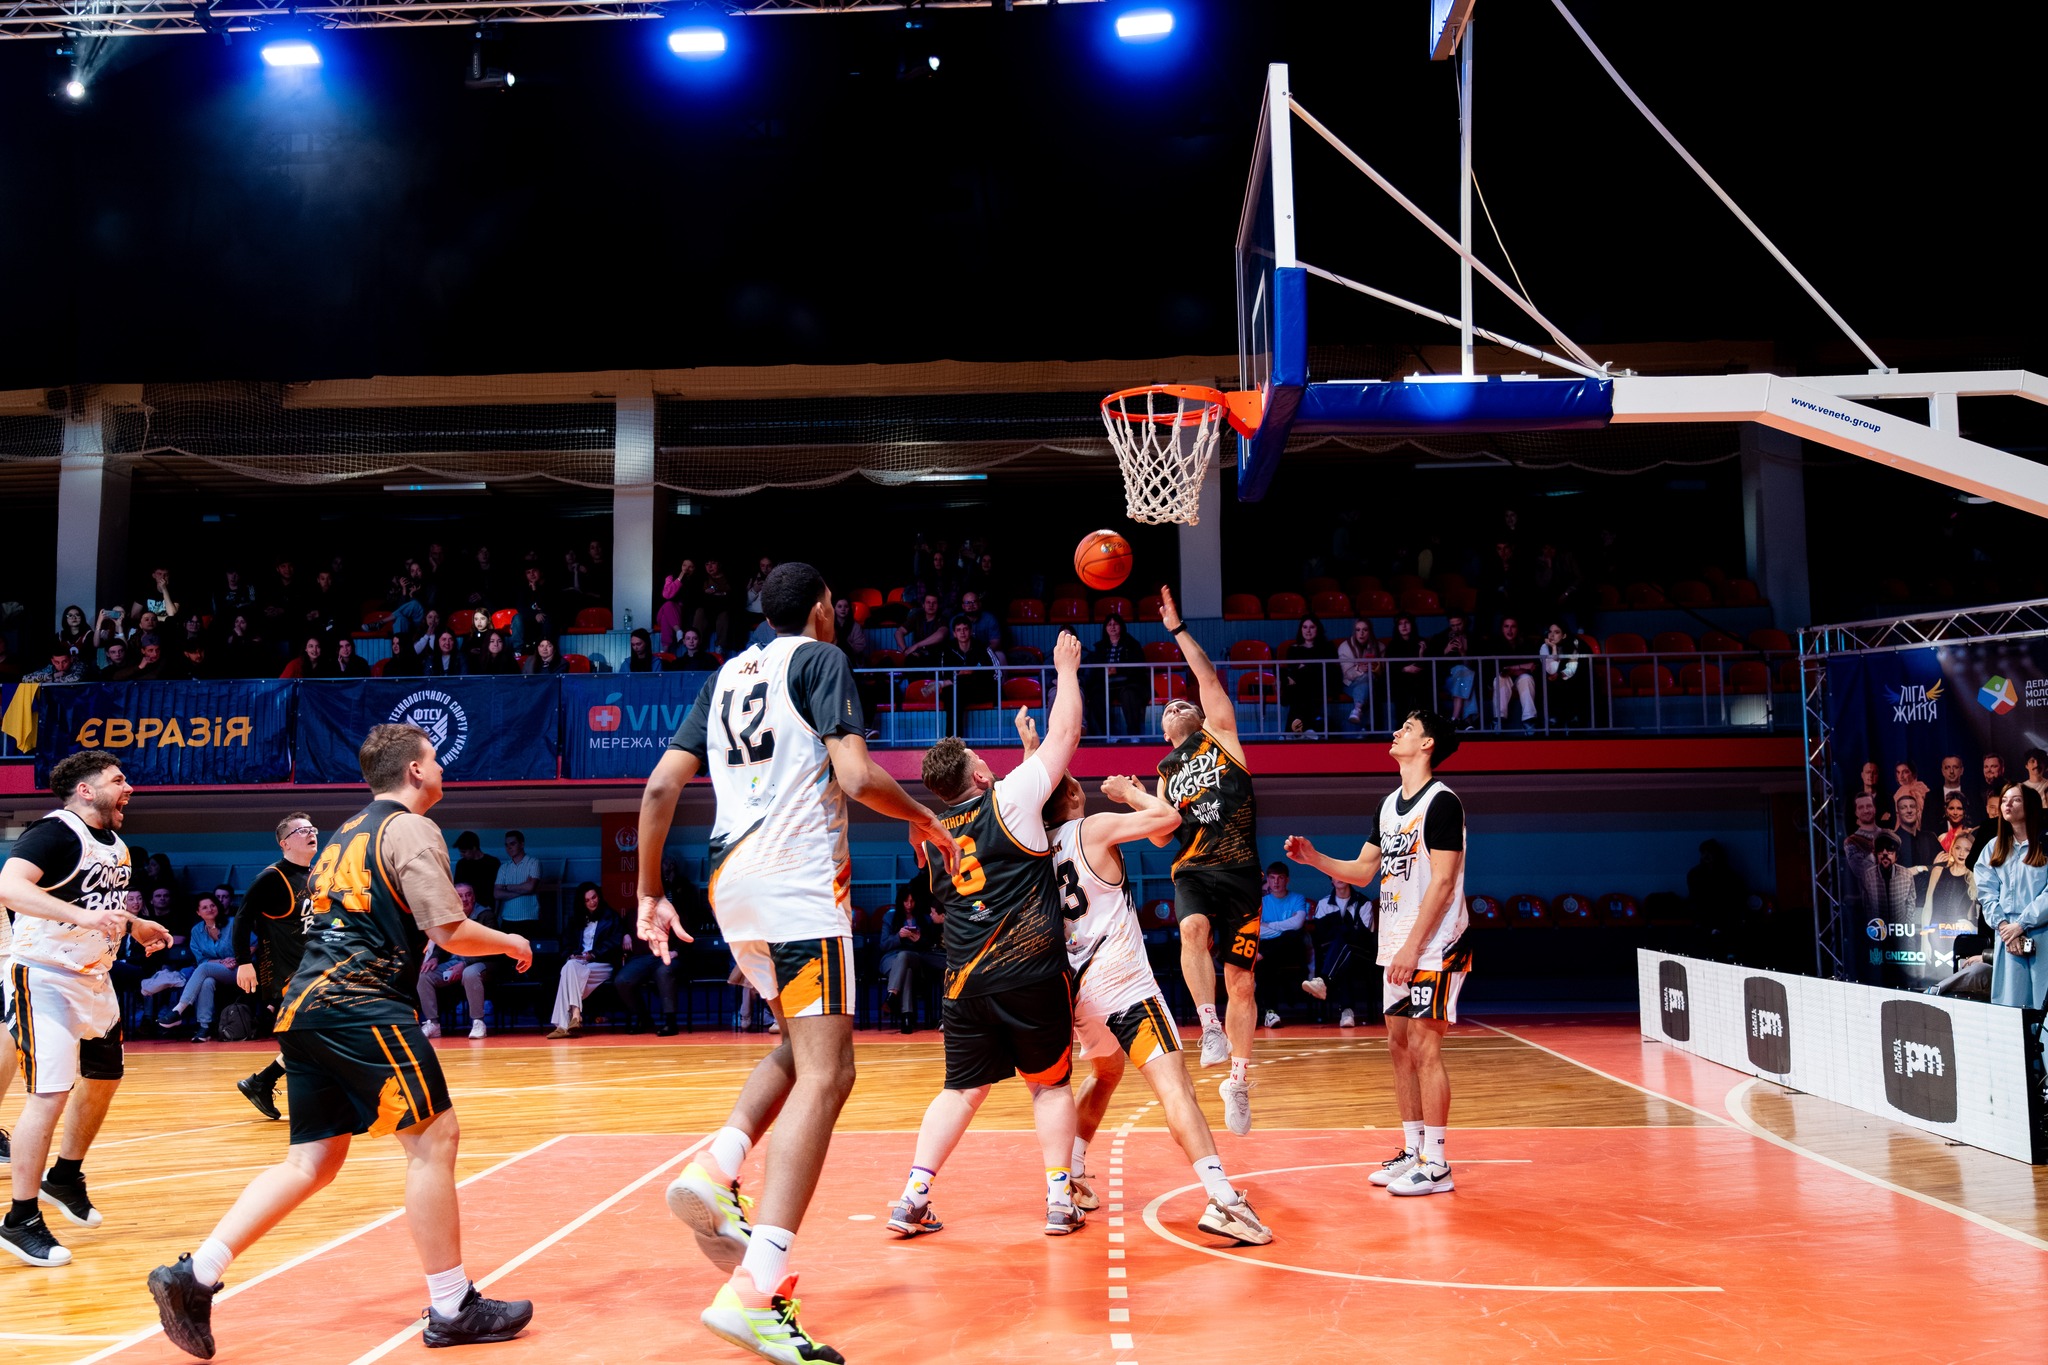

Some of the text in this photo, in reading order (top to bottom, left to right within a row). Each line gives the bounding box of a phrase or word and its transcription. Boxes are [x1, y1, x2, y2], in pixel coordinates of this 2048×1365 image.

[1791, 397, 1881, 433] www.veneto.group
[389, 690, 451, 722] ТЕХНОЛОГІЧНОГО
[1899, 684, 1928, 706] ЛІГА
[413, 708, 442, 721] ФТСУ
[449, 701, 468, 731] СПОРТУ
[718, 679, 776, 767] 12
[1893, 700, 1937, 724] ЖИТТЯ
[441, 735, 467, 766] УКРАЇНИ
[589, 737, 653, 749] МЕРЕЖА
[950, 834, 986, 897] 6
[1888, 923, 1916, 937] FBU
[1231, 935, 1256, 959] 26
[1885, 950, 1926, 962] GNIZDO
[1410, 986, 1433, 1006] 69
[1903, 1040, 1945, 1078] pm
